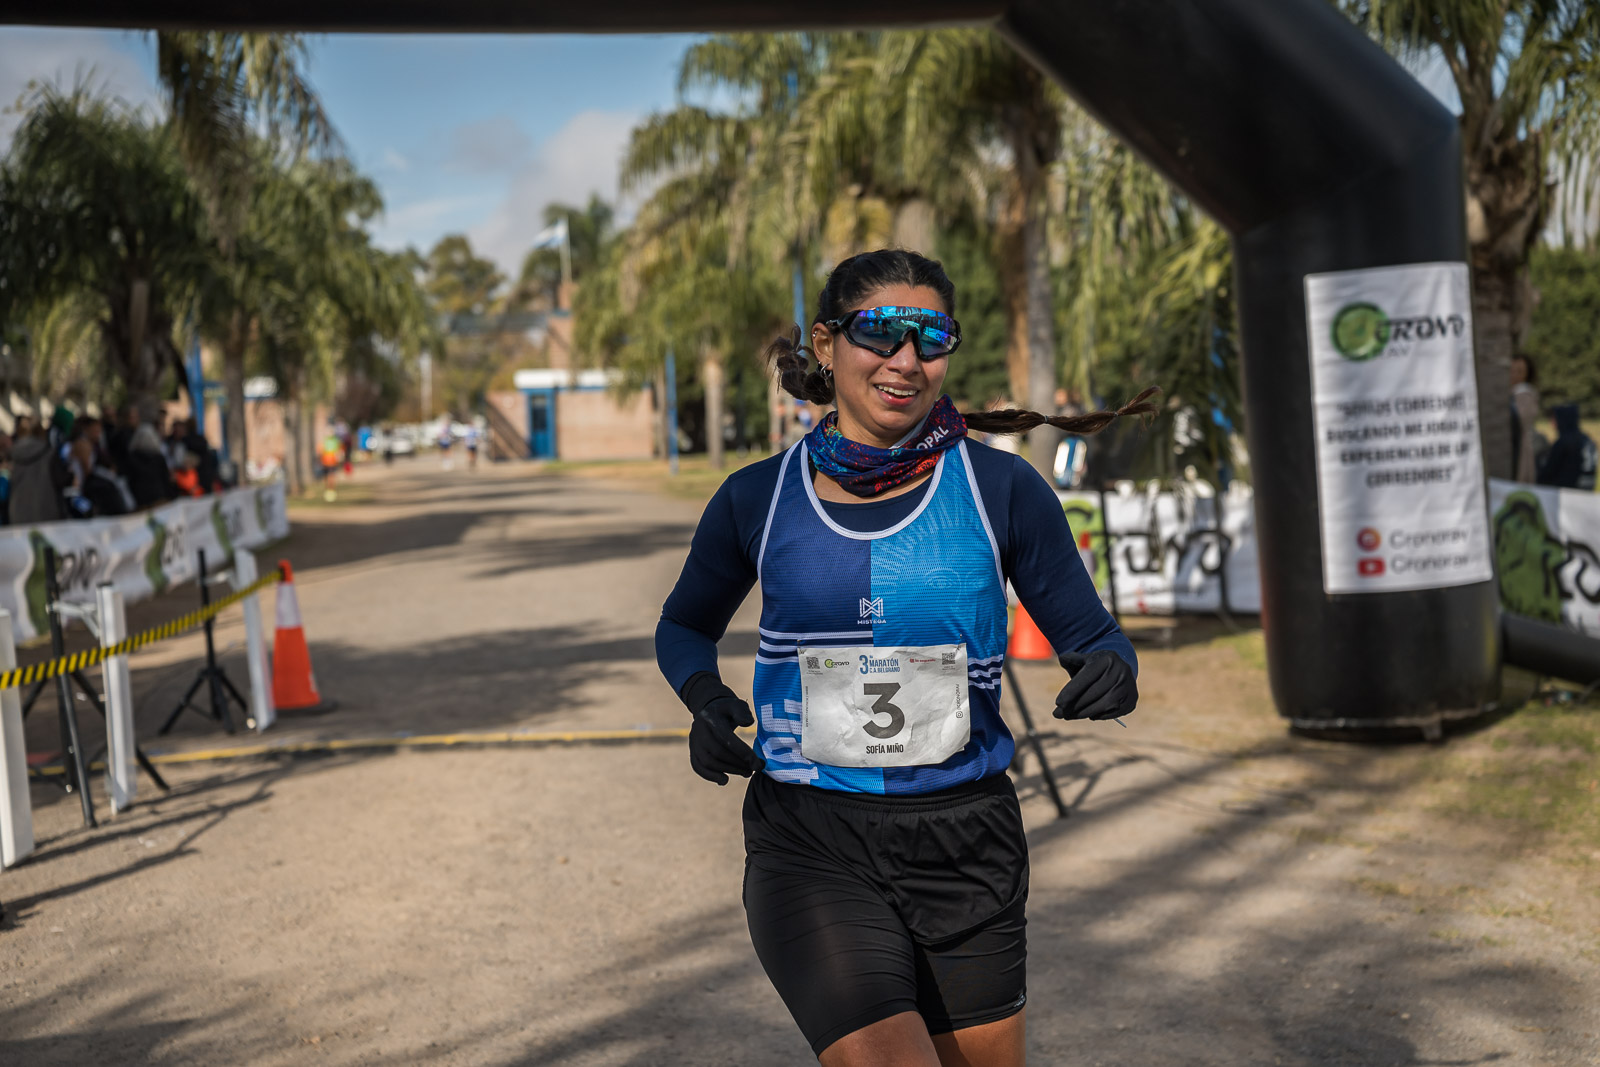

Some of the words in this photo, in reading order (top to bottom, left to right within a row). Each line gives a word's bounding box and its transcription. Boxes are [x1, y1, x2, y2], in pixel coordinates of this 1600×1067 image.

[916, 425, 949, 449] OPAL
[859, 654, 869, 675] 3
[869, 658, 899, 667] MARATÓN
[862, 682, 906, 740] 3
[865, 743, 886, 755] SOFÍA
[886, 742, 904, 754] MIÑO
